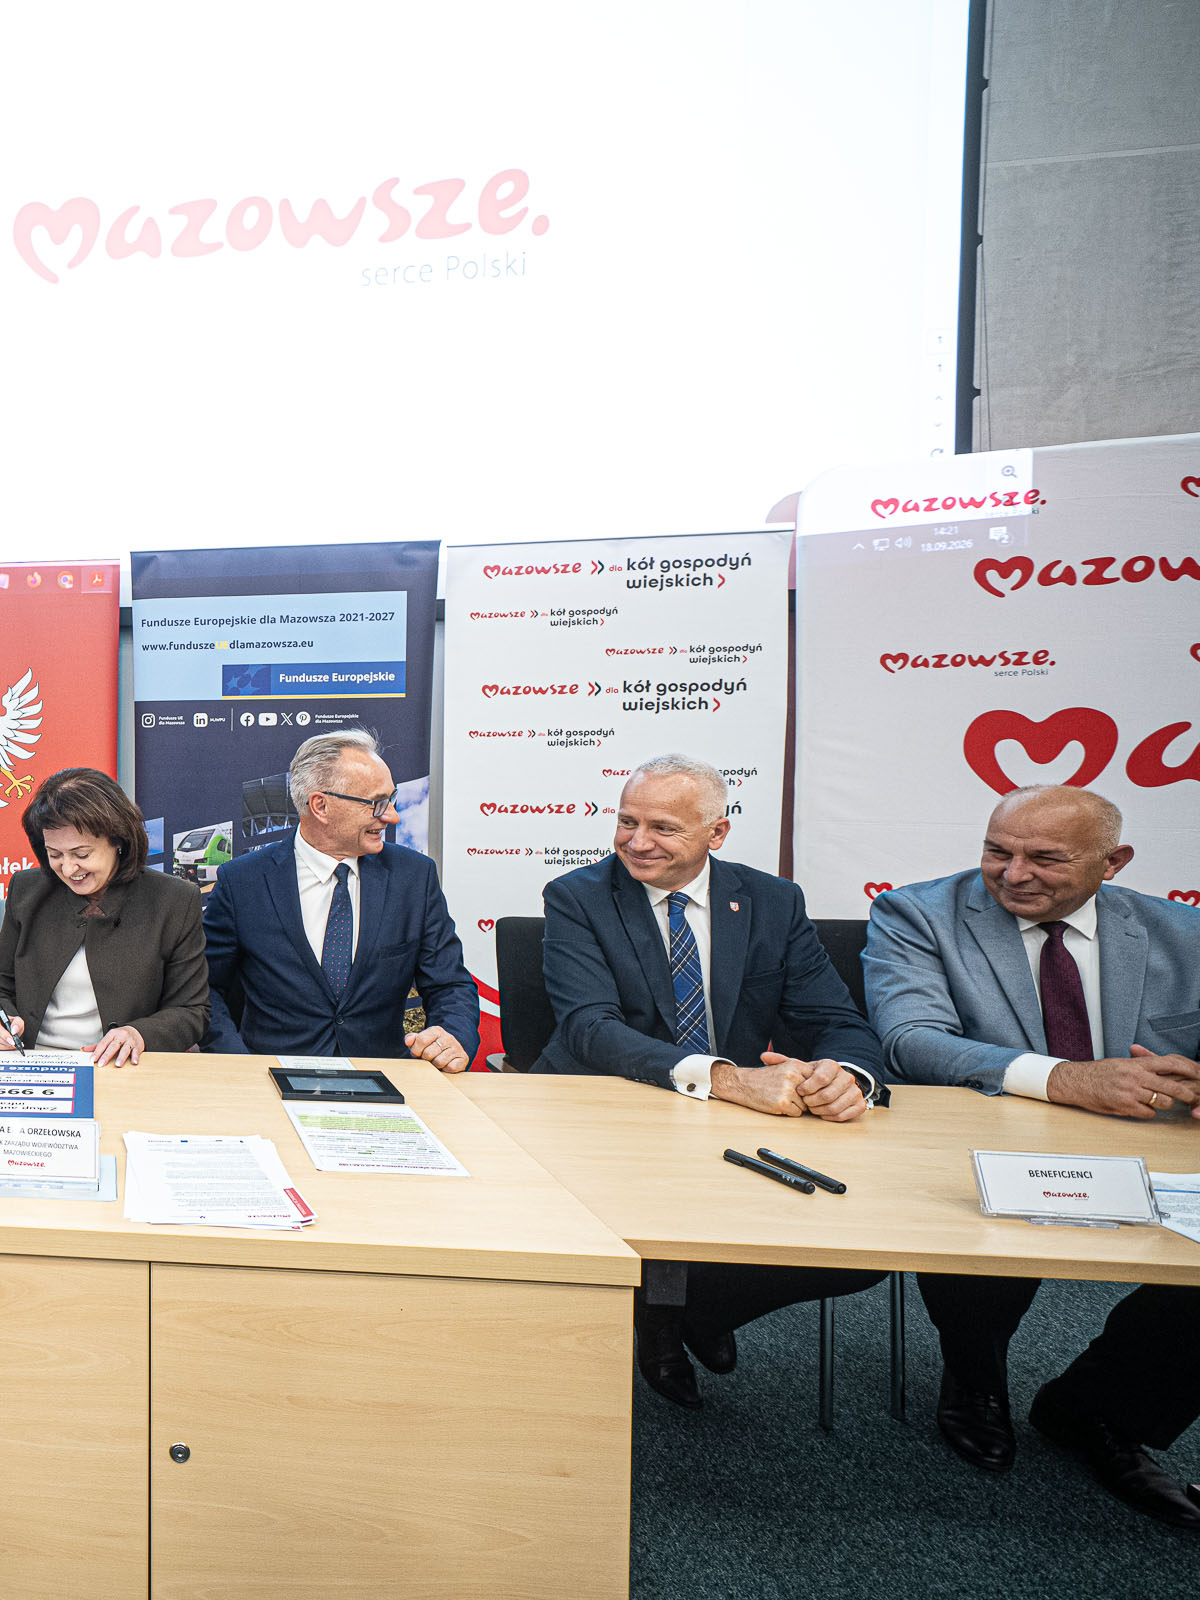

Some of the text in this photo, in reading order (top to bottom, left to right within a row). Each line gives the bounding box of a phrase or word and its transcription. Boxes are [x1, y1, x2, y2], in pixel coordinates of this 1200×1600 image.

[13, 168, 550, 284] Mazowsze.
[361, 251, 527, 287] serce Polski
[870, 488, 1047, 518] Mazowsze.
[483, 561, 582, 579] Mazowsze
[626, 558, 655, 571] kół
[660, 553, 752, 573] gospodyń
[626, 573, 713, 591] wiejskich
[470, 606, 618, 620] Mazowsze kół gospodyń
[141, 612, 395, 628] Fundusze Europejskie dla Mazowsza 2021-2027
[550, 617, 598, 627] wiejskich
[605, 642, 762, 657] Mazowsze kół gospodyń
[689, 654, 740, 665] wiejskich
[880, 649, 1056, 674] Mazowsze.
[279, 671, 395, 684] Fundusze Europejskie
[994, 668, 1049, 677] serce Polski
[481, 682, 579, 699] Mazowsze
[622, 680, 651, 693] kół
[655, 677, 747, 695] gospodyń
[622, 697, 708, 713] wiejskich
[468, 727, 615, 739] Mazowsze kół gospodyń
[547, 738, 595, 748] wiejskich
[480, 802, 576, 816] Mazowsze
[467, 846, 612, 857] Mazowsze kół gospodyń
[544, 856, 592, 866] wiejskich
[27, 1127, 82, 1138] ORZEŁOWSKA
[4, 1140, 30, 1148] ZARZĄDU
[31, 1141, 79, 1150] WOJEWÓDZTWA
[3, 1149, 52, 1158] MAZOWIECKIEGO
[1028, 1169, 1093, 1179] BENEFICJENCI
